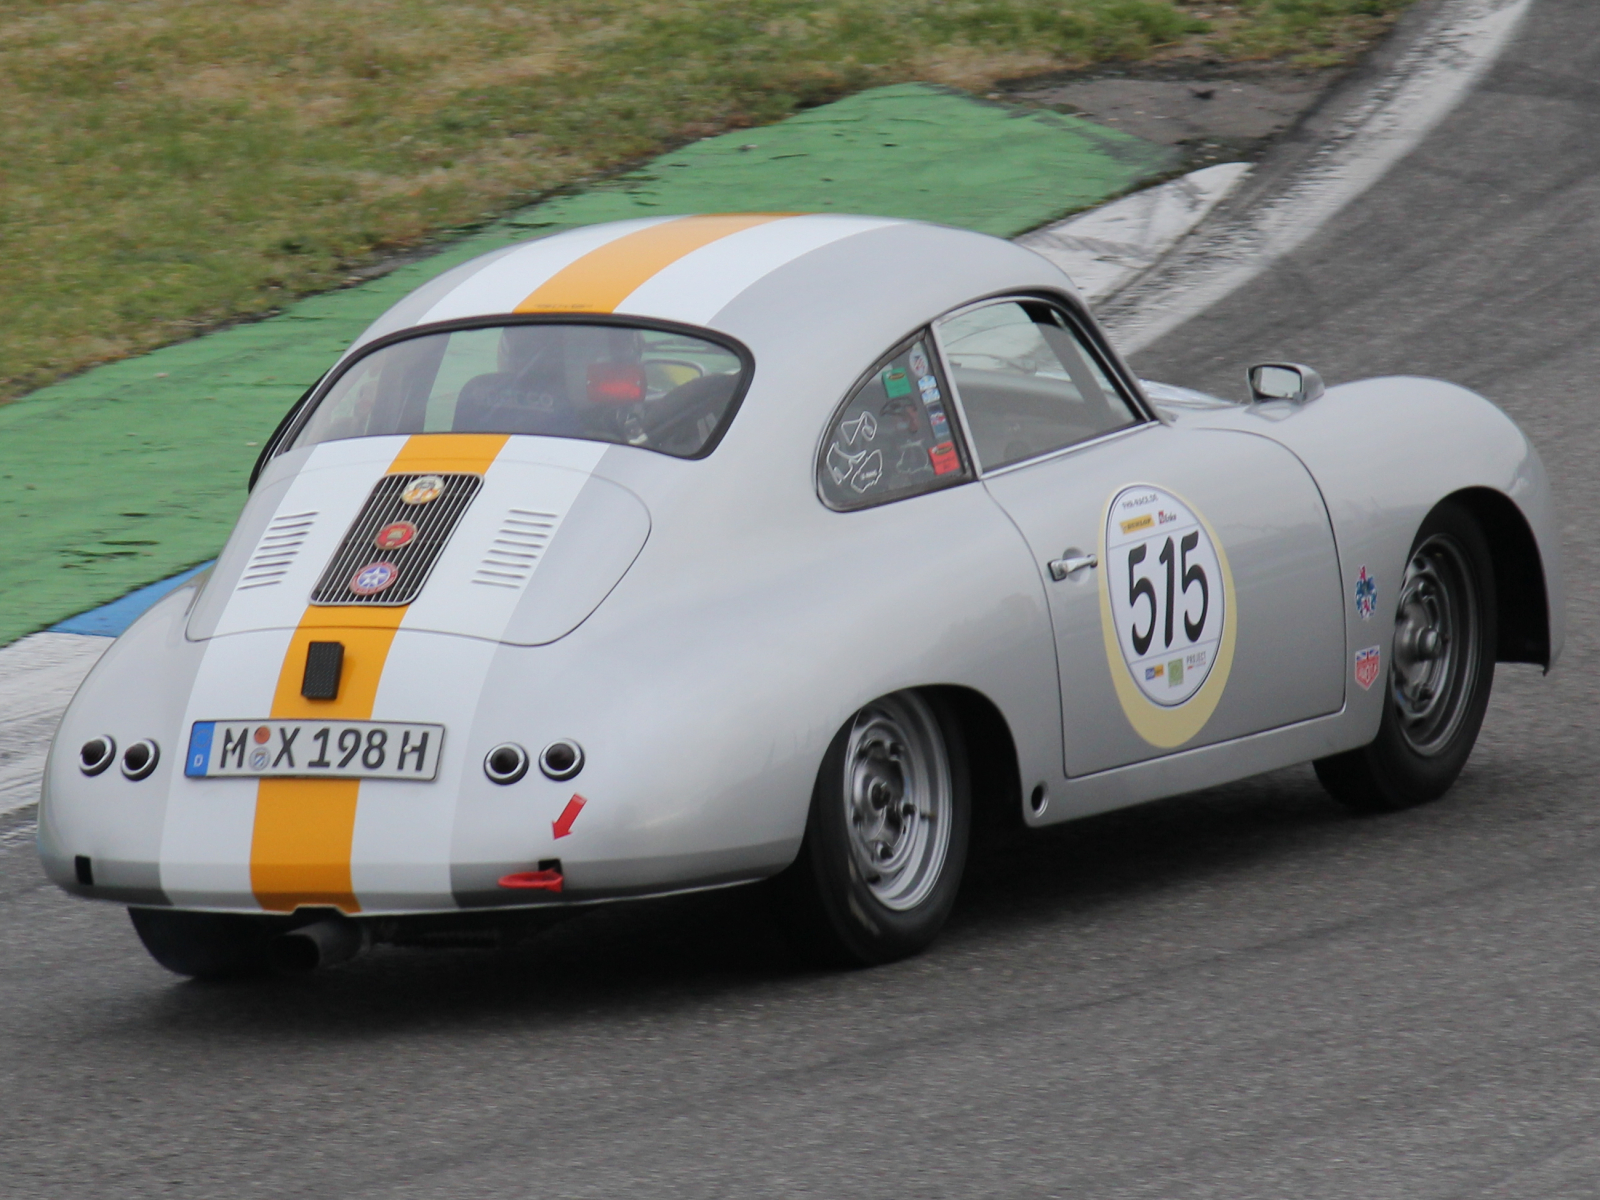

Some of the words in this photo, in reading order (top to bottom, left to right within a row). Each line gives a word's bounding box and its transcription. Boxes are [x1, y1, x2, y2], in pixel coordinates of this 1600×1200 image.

[1128, 530, 1209, 656] 515
[193, 753, 204, 768] D
[219, 727, 249, 769] M
[271, 727, 301, 768] X
[307, 728, 388, 770] 198
[397, 730, 430, 771] H
